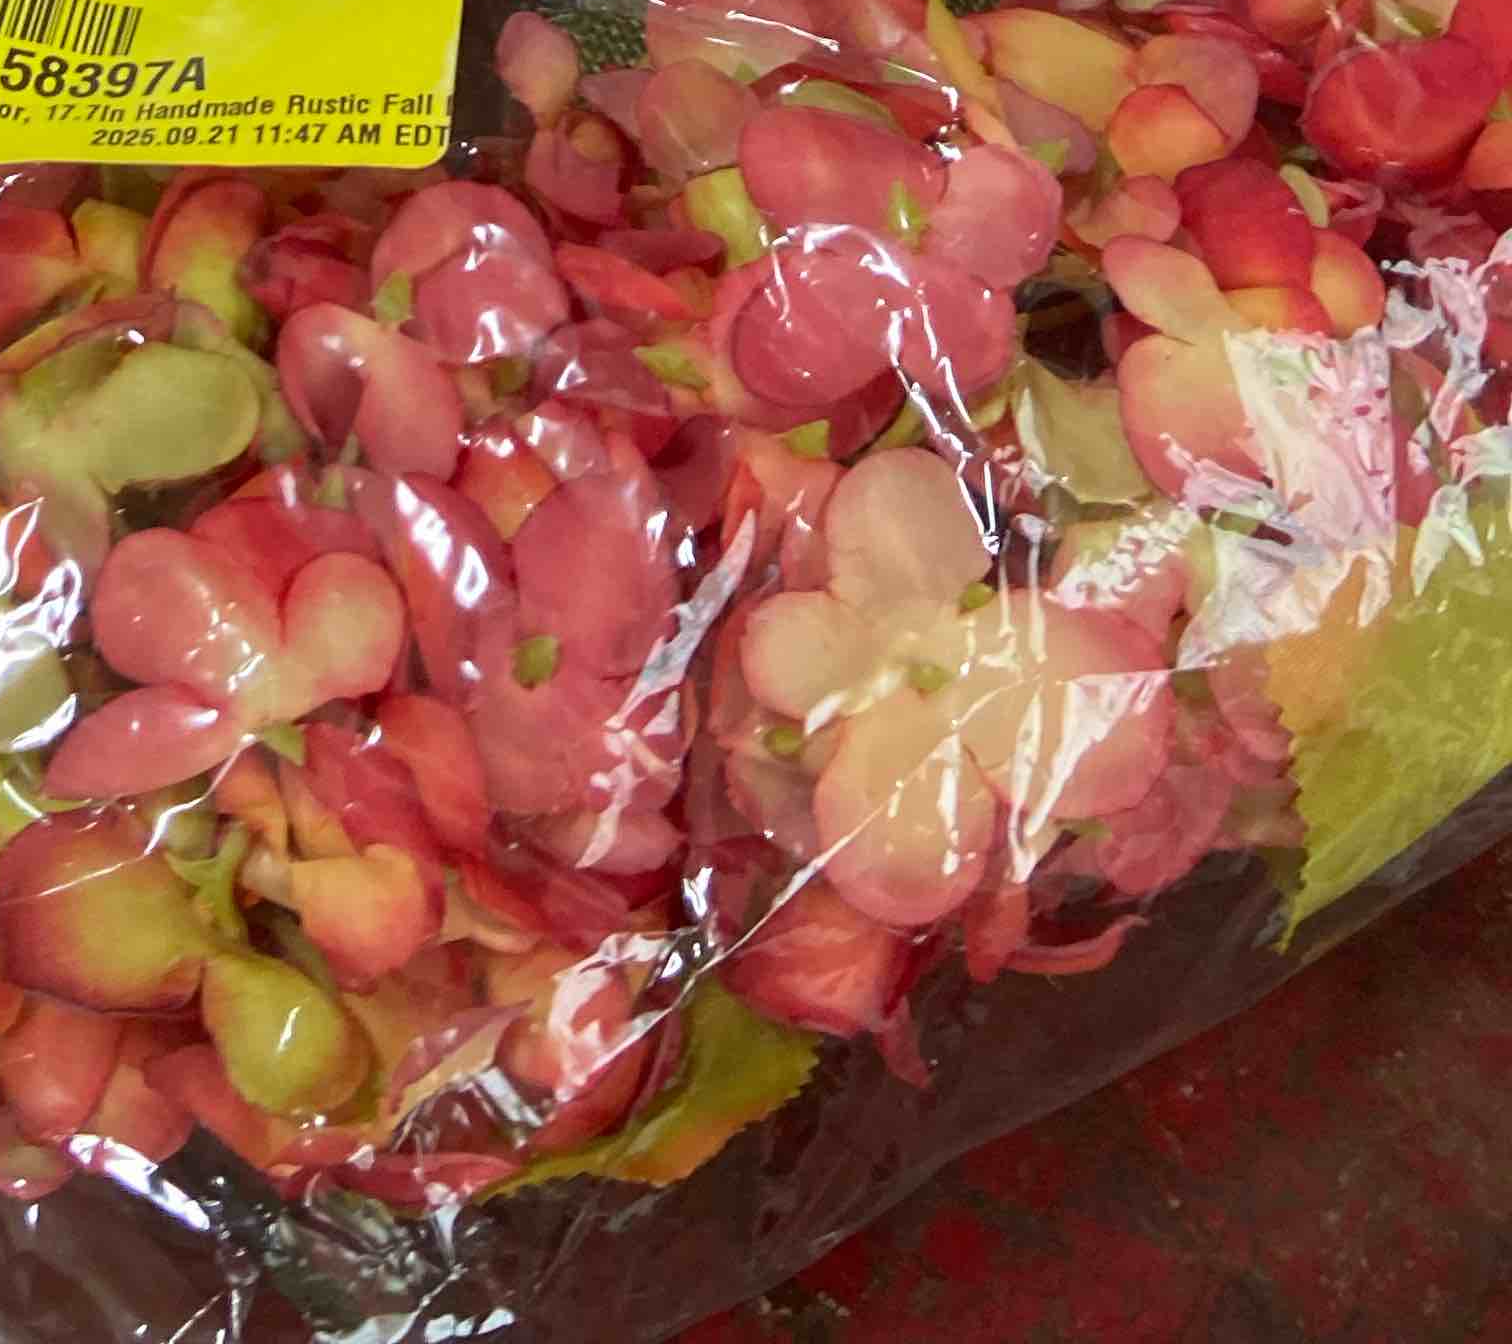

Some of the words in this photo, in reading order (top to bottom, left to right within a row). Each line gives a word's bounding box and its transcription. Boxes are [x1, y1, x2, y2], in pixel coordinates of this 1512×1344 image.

[136, 95, 276, 122] Handmade
[287, 93, 372, 116] Rustic
[383, 93, 435, 116] Fall
[90, 126, 239, 148] 2025.09.21
[253, 124, 328, 145] 11:47
[336, 123, 382, 145] AM
[395, 124, 448, 147] EDT
